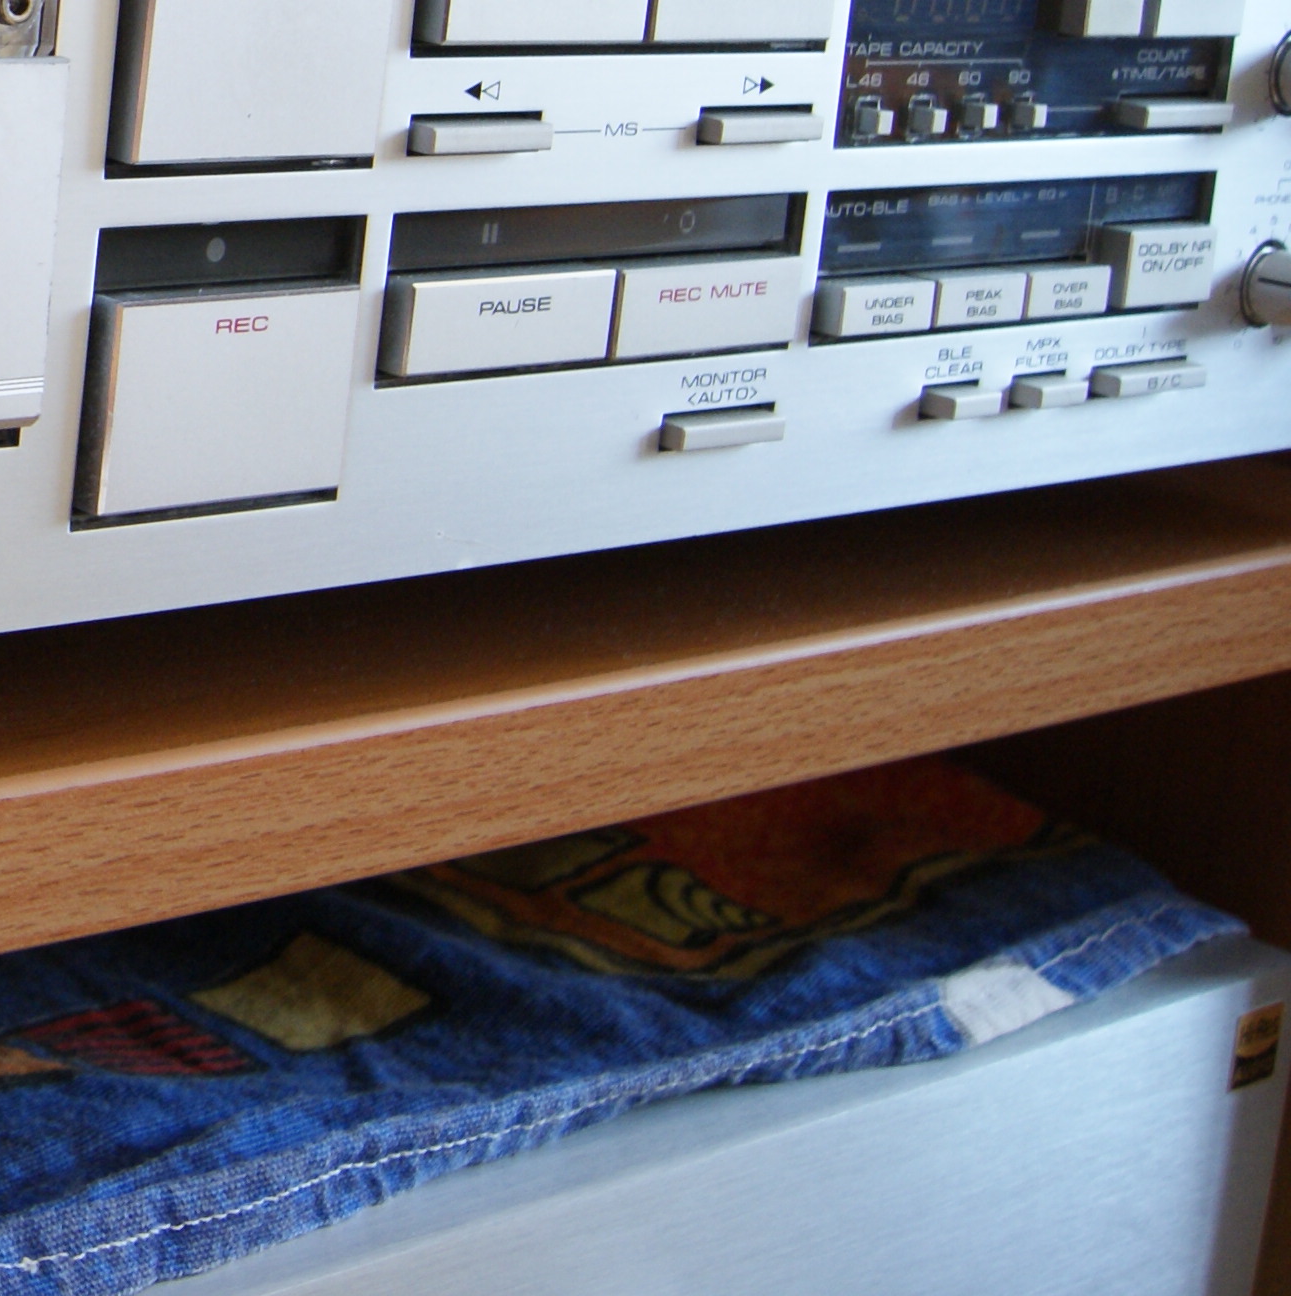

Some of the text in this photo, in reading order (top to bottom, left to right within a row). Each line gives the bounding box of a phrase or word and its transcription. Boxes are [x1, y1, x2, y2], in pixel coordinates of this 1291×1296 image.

[846, 40, 984, 56] TAPE CAPACITY
[1137, 48, 1189, 64] COUNT
[604, 122, 638, 137] MS
[1138, 239, 1212, 256] DOLBY NR
[1142, 257, 1205, 273] ON/OFF
[659, 281, 768, 304] REC MUTE
[965, 289, 1002, 301] PEAK
[1053, 282, 1088, 294] OVER
[478, 296, 553, 316] PAUSE
[864, 296, 915, 310] UNDER
[966, 305, 997, 317] BIAS
[1054, 297, 1083, 310] BIAS
[215, 315, 269, 334] REC
[871, 314, 904, 326] BIAS
[1026, 337, 1062, 351] MPX
[1094, 339, 1188, 361] DOLBY TYPE
[938, 346, 973, 360] BLE
[1015, 352, 1068, 368] FILTER
[925, 361, 983, 380] CLEAR
[680, 368, 768, 390] MONITOR
[1148, 374, 1182, 389] B/C
